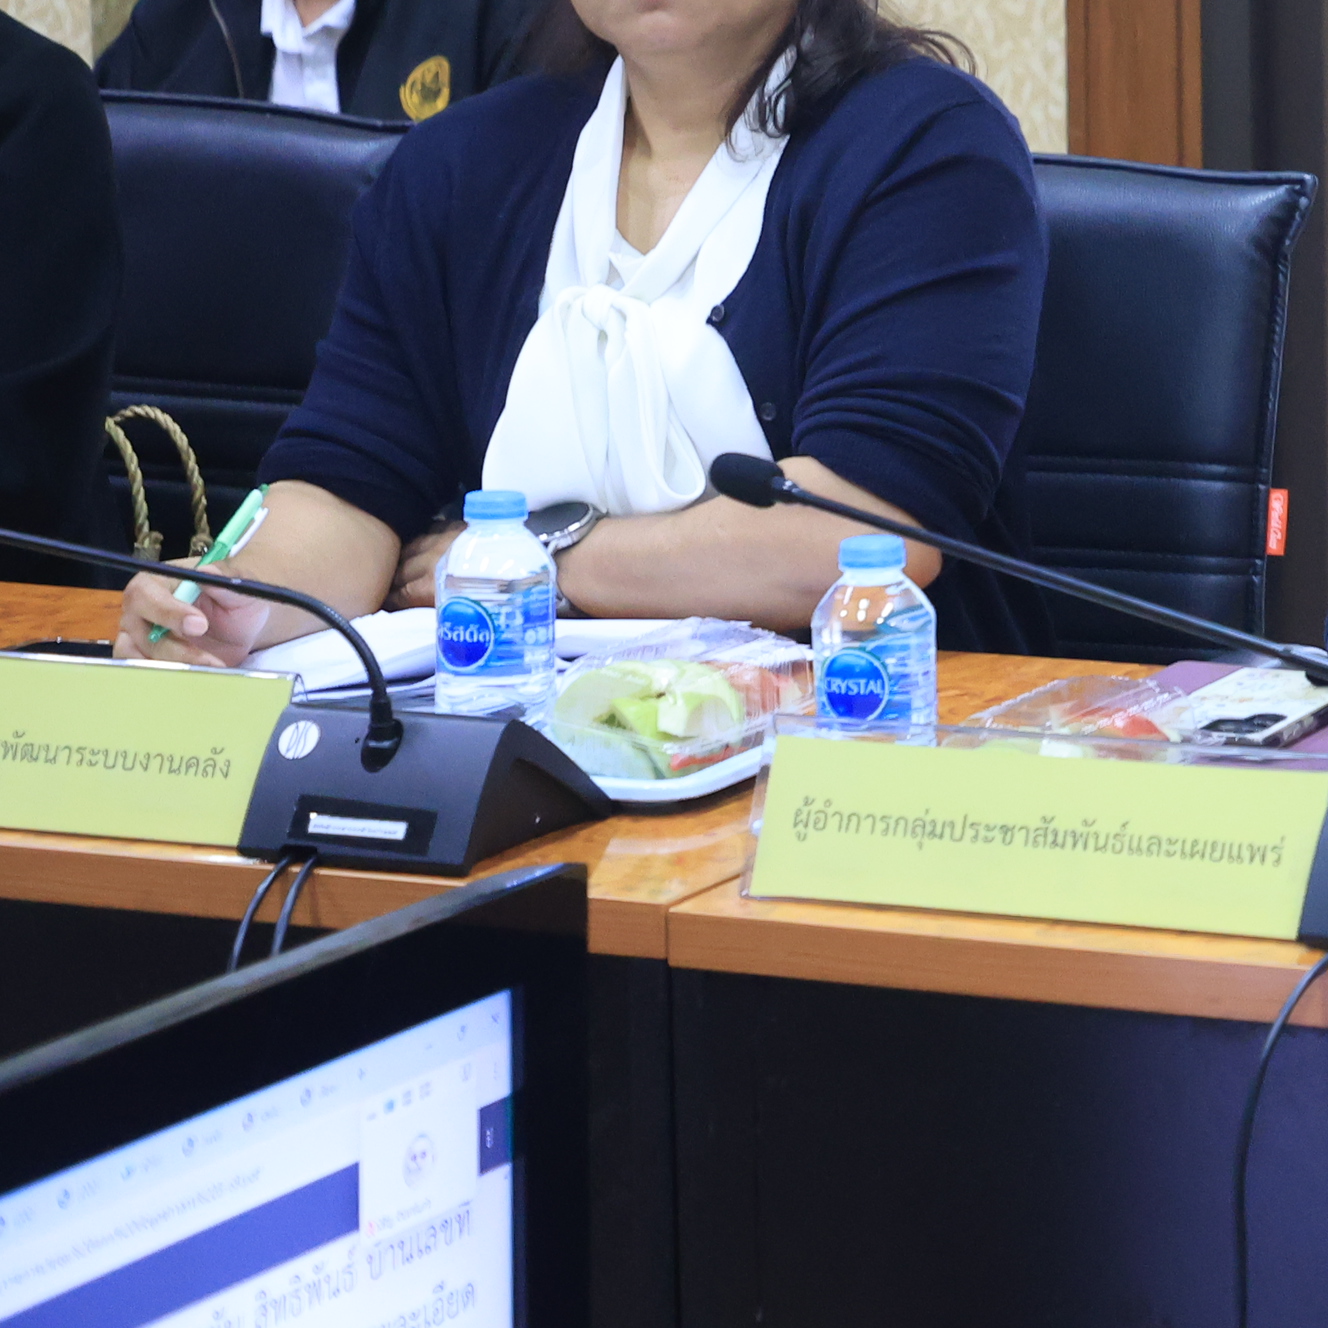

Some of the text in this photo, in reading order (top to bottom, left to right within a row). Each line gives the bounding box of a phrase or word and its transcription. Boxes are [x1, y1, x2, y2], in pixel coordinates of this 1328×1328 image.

[825, 677, 885, 696] CRYSTAL
[1, 729, 232, 780] พัฒนาระบบงานคลัง
